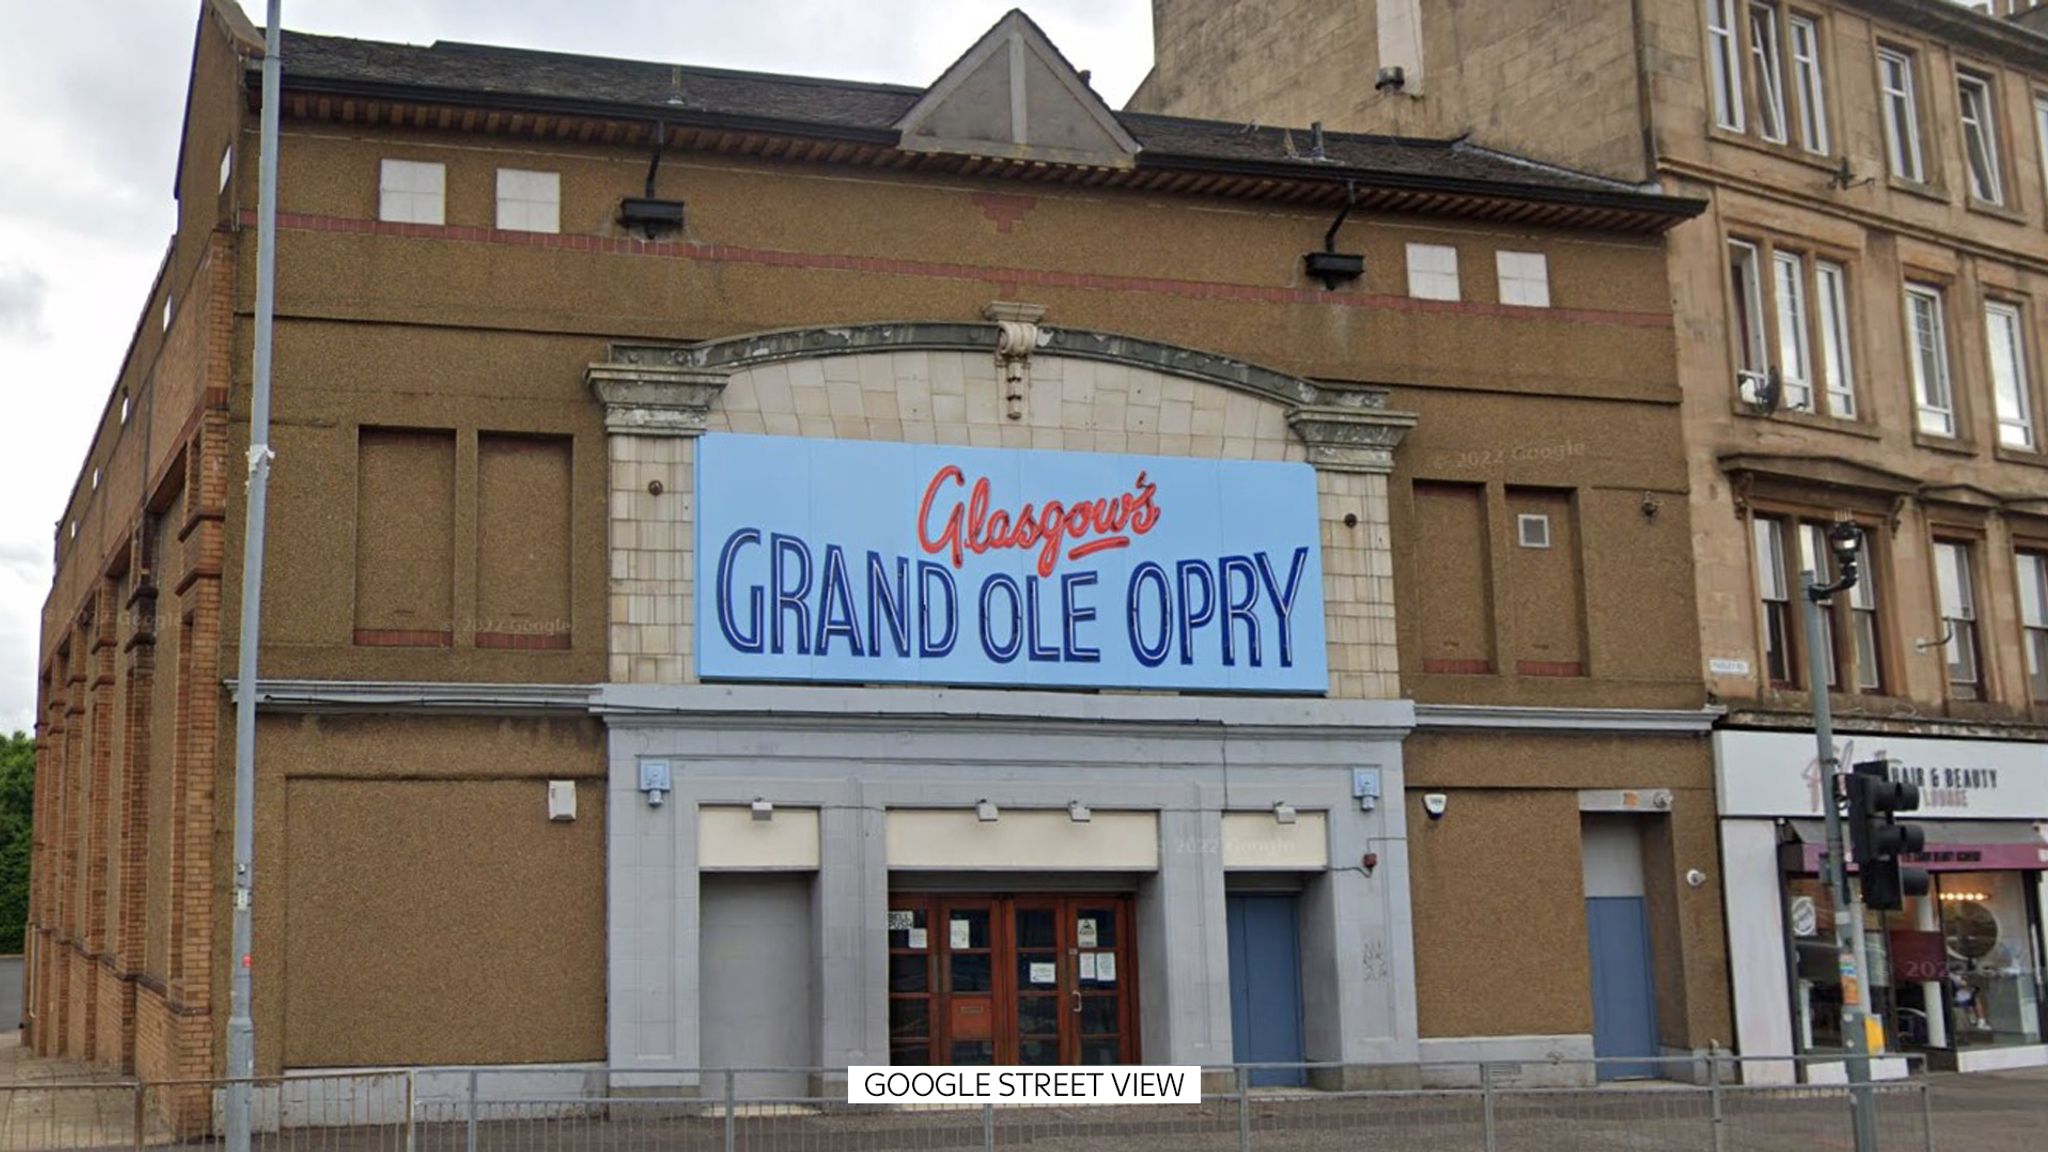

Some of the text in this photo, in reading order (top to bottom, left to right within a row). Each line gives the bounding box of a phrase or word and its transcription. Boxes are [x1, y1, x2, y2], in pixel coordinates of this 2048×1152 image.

[917, 464, 1161, 577] Glasgow's
[716, 527, 1309, 668] GRAND OLE OPRY
[1945, 767, 1997, 789] BEAUTY
